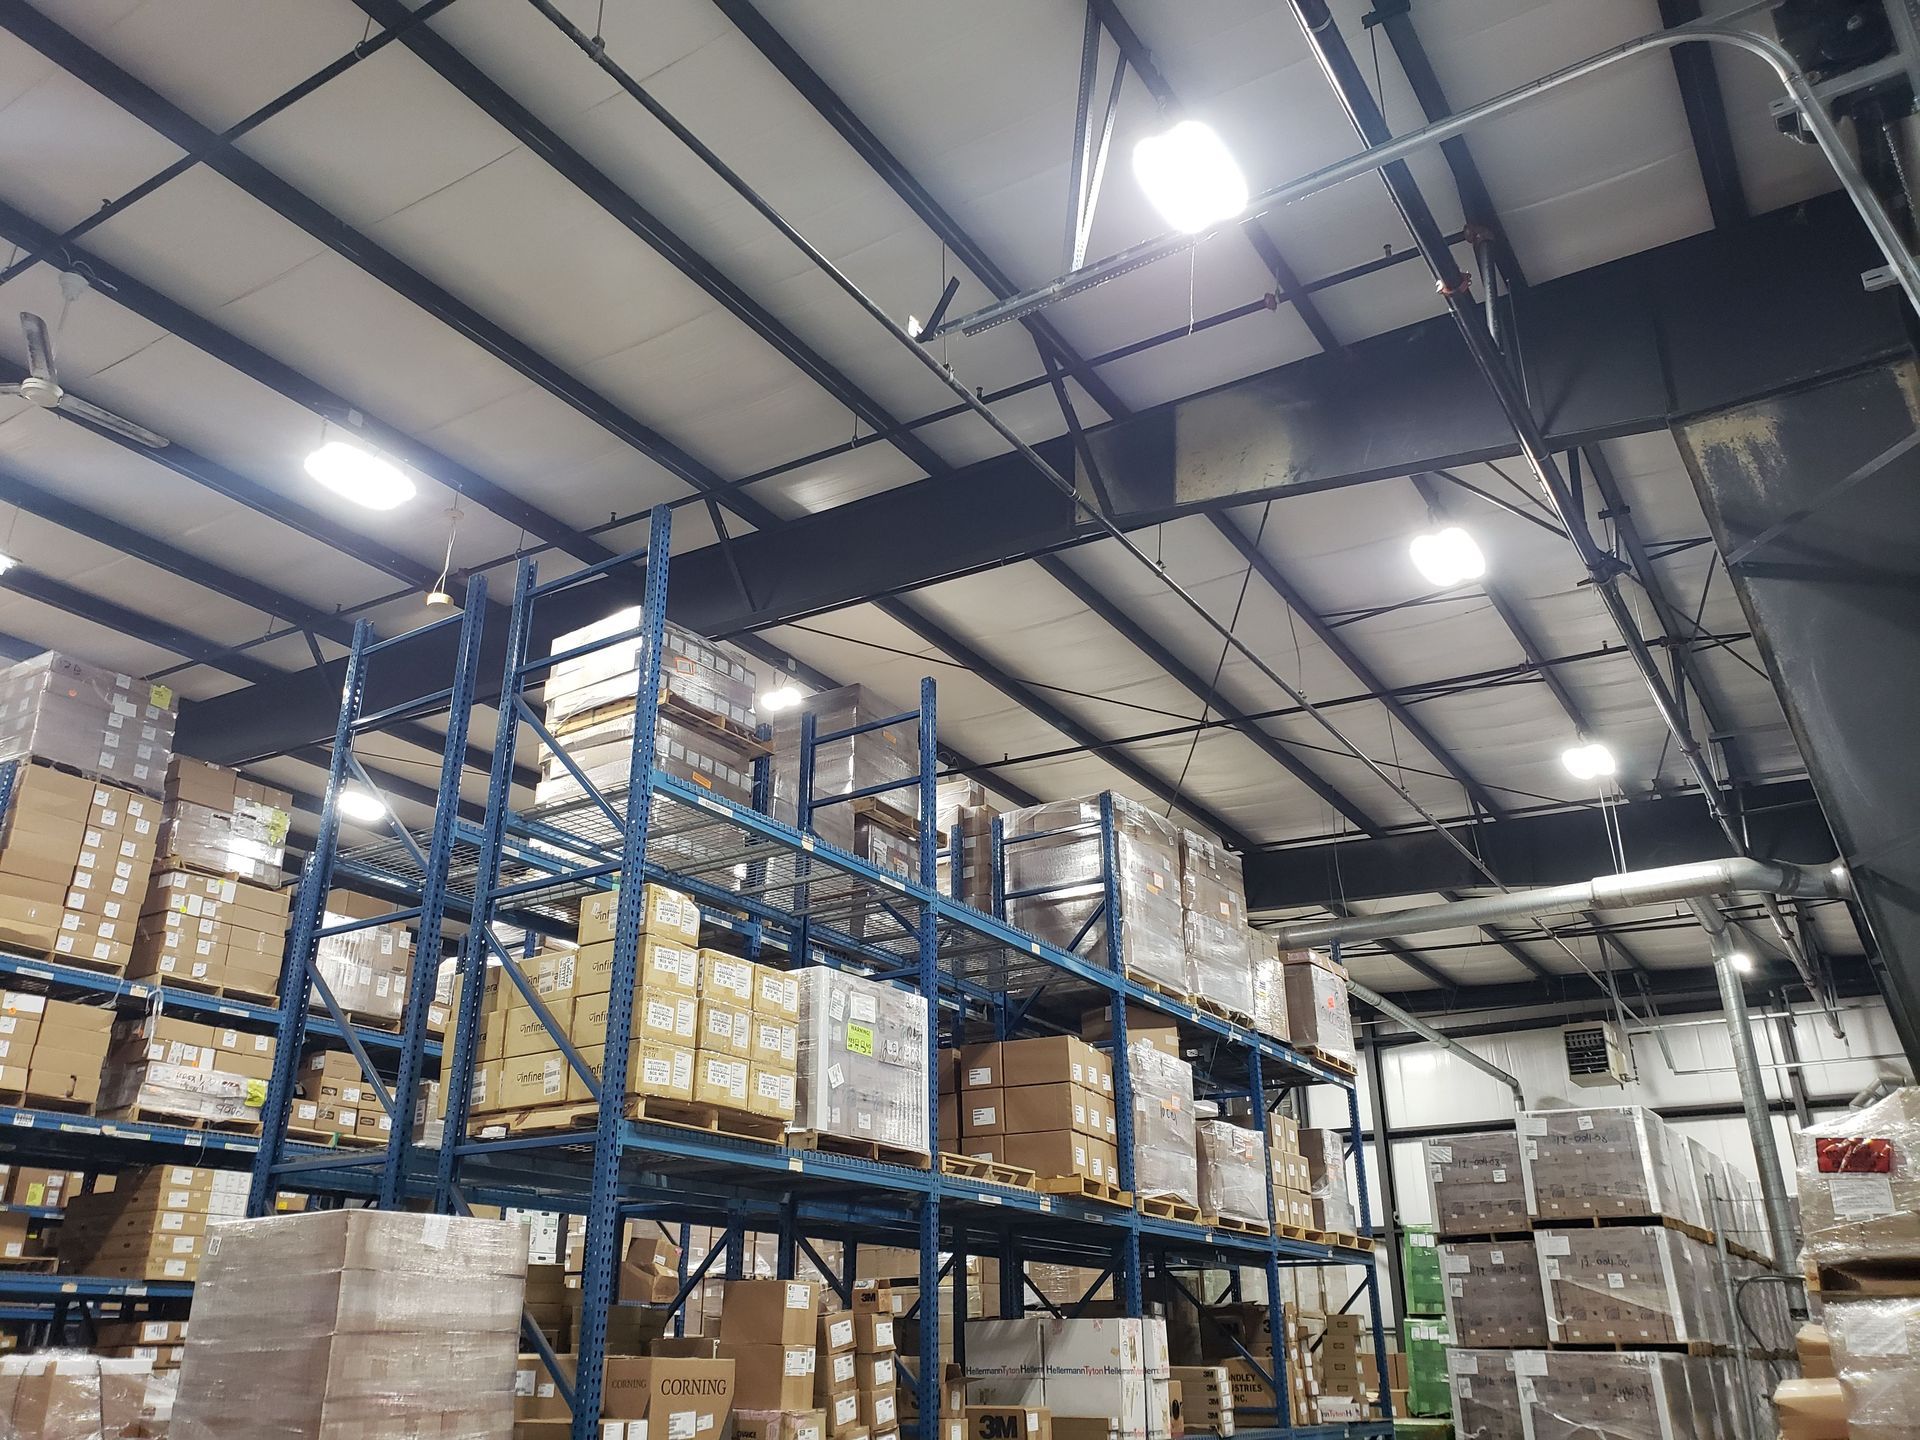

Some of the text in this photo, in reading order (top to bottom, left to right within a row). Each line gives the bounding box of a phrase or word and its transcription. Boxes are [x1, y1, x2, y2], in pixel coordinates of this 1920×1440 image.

[860, 1293, 876, 1302] 3M
[612, 1378, 646, 1389] CORNING
[661, 1379, 727, 1396] CORNING
[979, 1415, 1018, 1438] 3M
